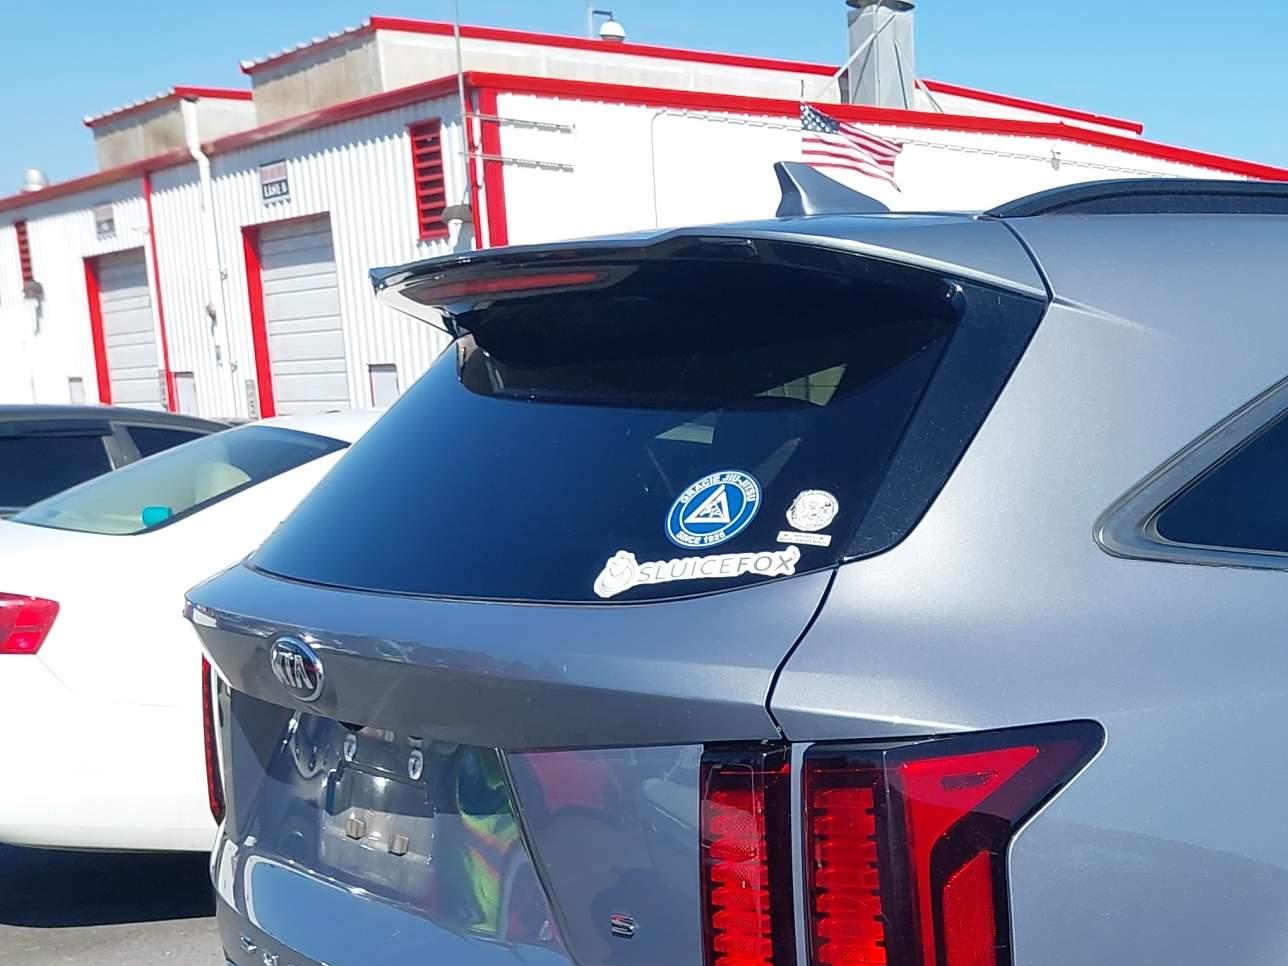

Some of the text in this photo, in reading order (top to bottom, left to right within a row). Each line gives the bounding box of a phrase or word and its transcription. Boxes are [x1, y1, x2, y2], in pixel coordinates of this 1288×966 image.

[680, 473, 757, 504] GRACIE JIU-JITSU
[676, 531, 701, 545] SINCE
[640, 554, 793, 582] SLUICEFOX
